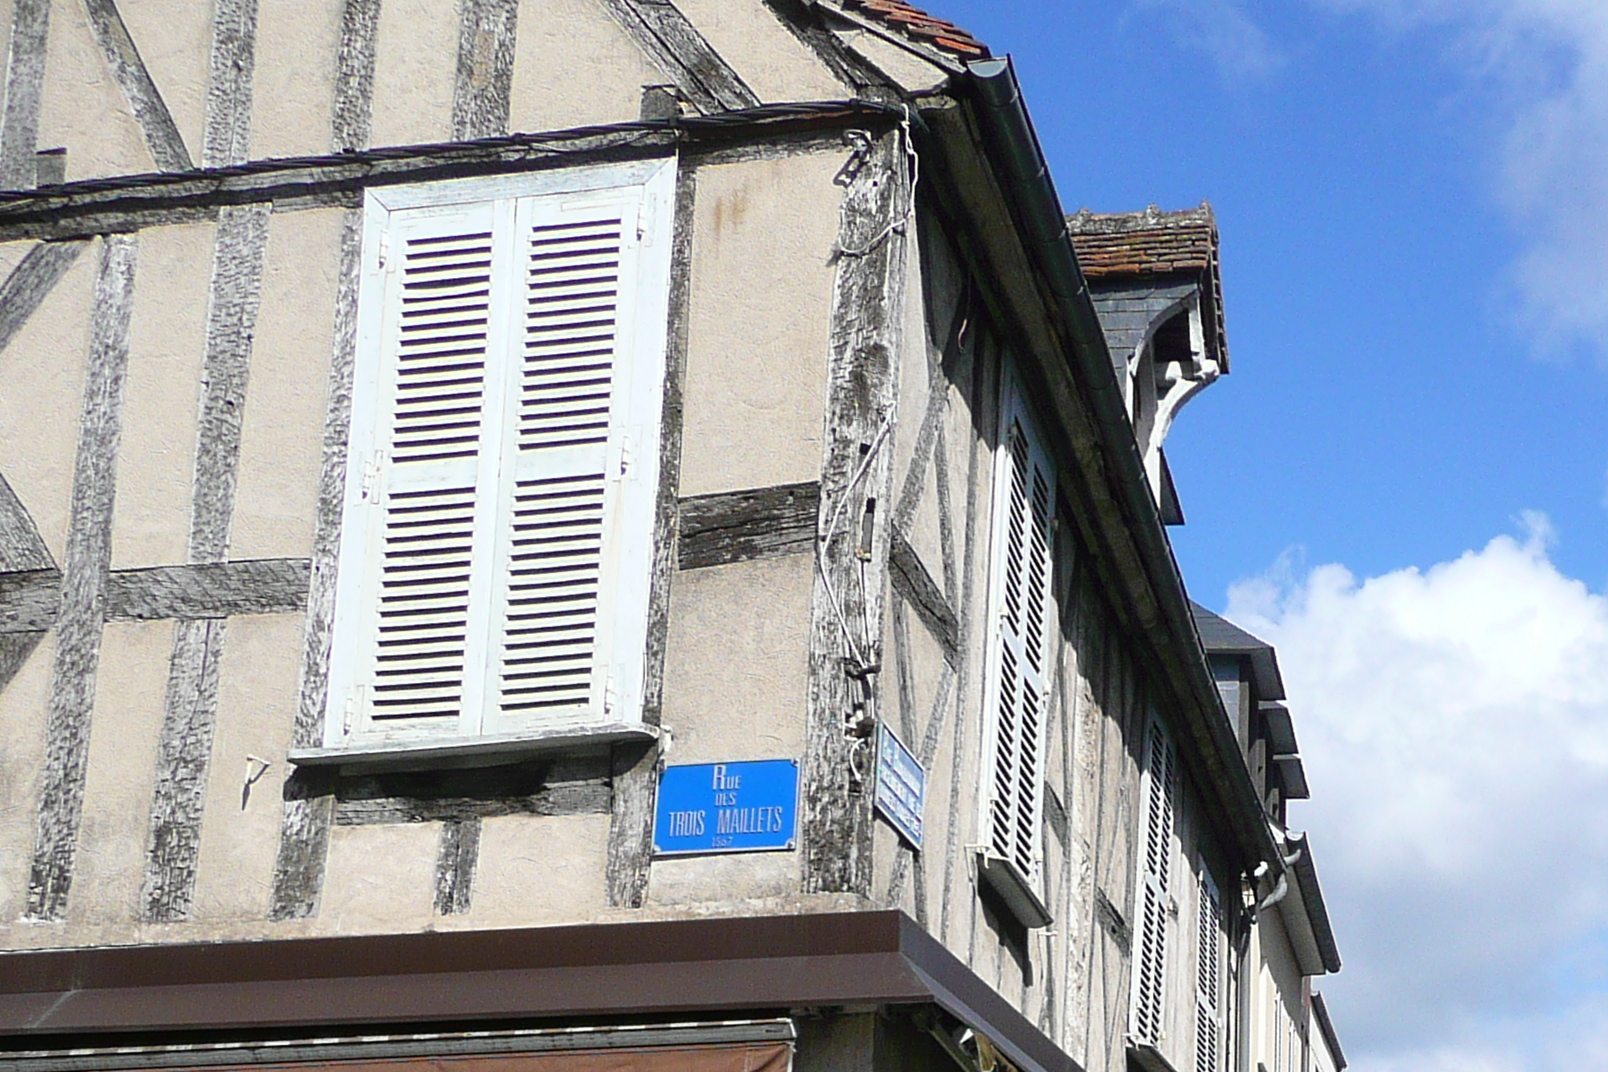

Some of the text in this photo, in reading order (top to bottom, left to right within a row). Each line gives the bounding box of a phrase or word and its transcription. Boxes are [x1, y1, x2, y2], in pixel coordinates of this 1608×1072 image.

[714, 791, 738, 807] DES
[668, 805, 783, 837] TROIS MAILLETS
